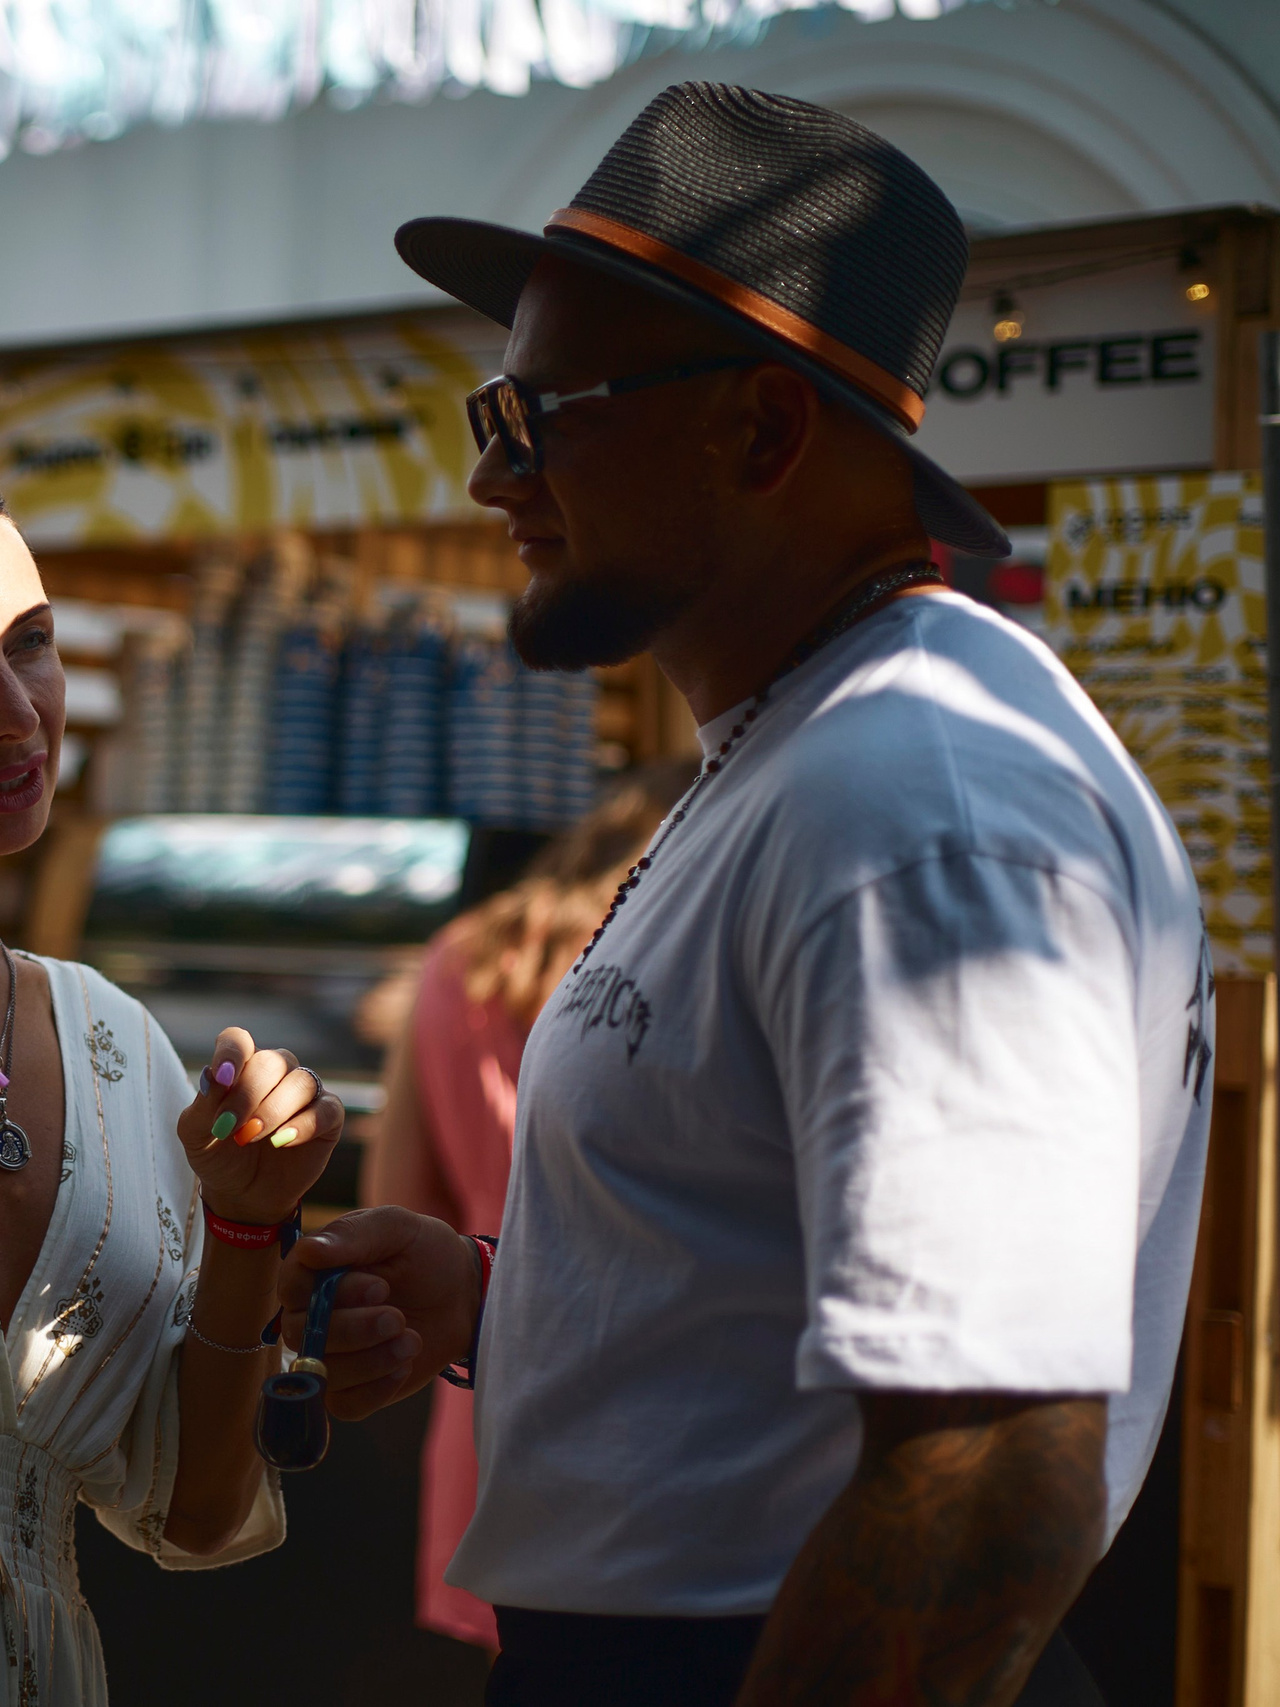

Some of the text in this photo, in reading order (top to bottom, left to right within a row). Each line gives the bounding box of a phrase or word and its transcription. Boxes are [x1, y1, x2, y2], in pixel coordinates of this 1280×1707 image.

[927, 329, 1201, 397] OFFEE
[1066, 578, 1226, 614] МЕНЮ
[212, 1222, 271, 1242] Альфа Банк
